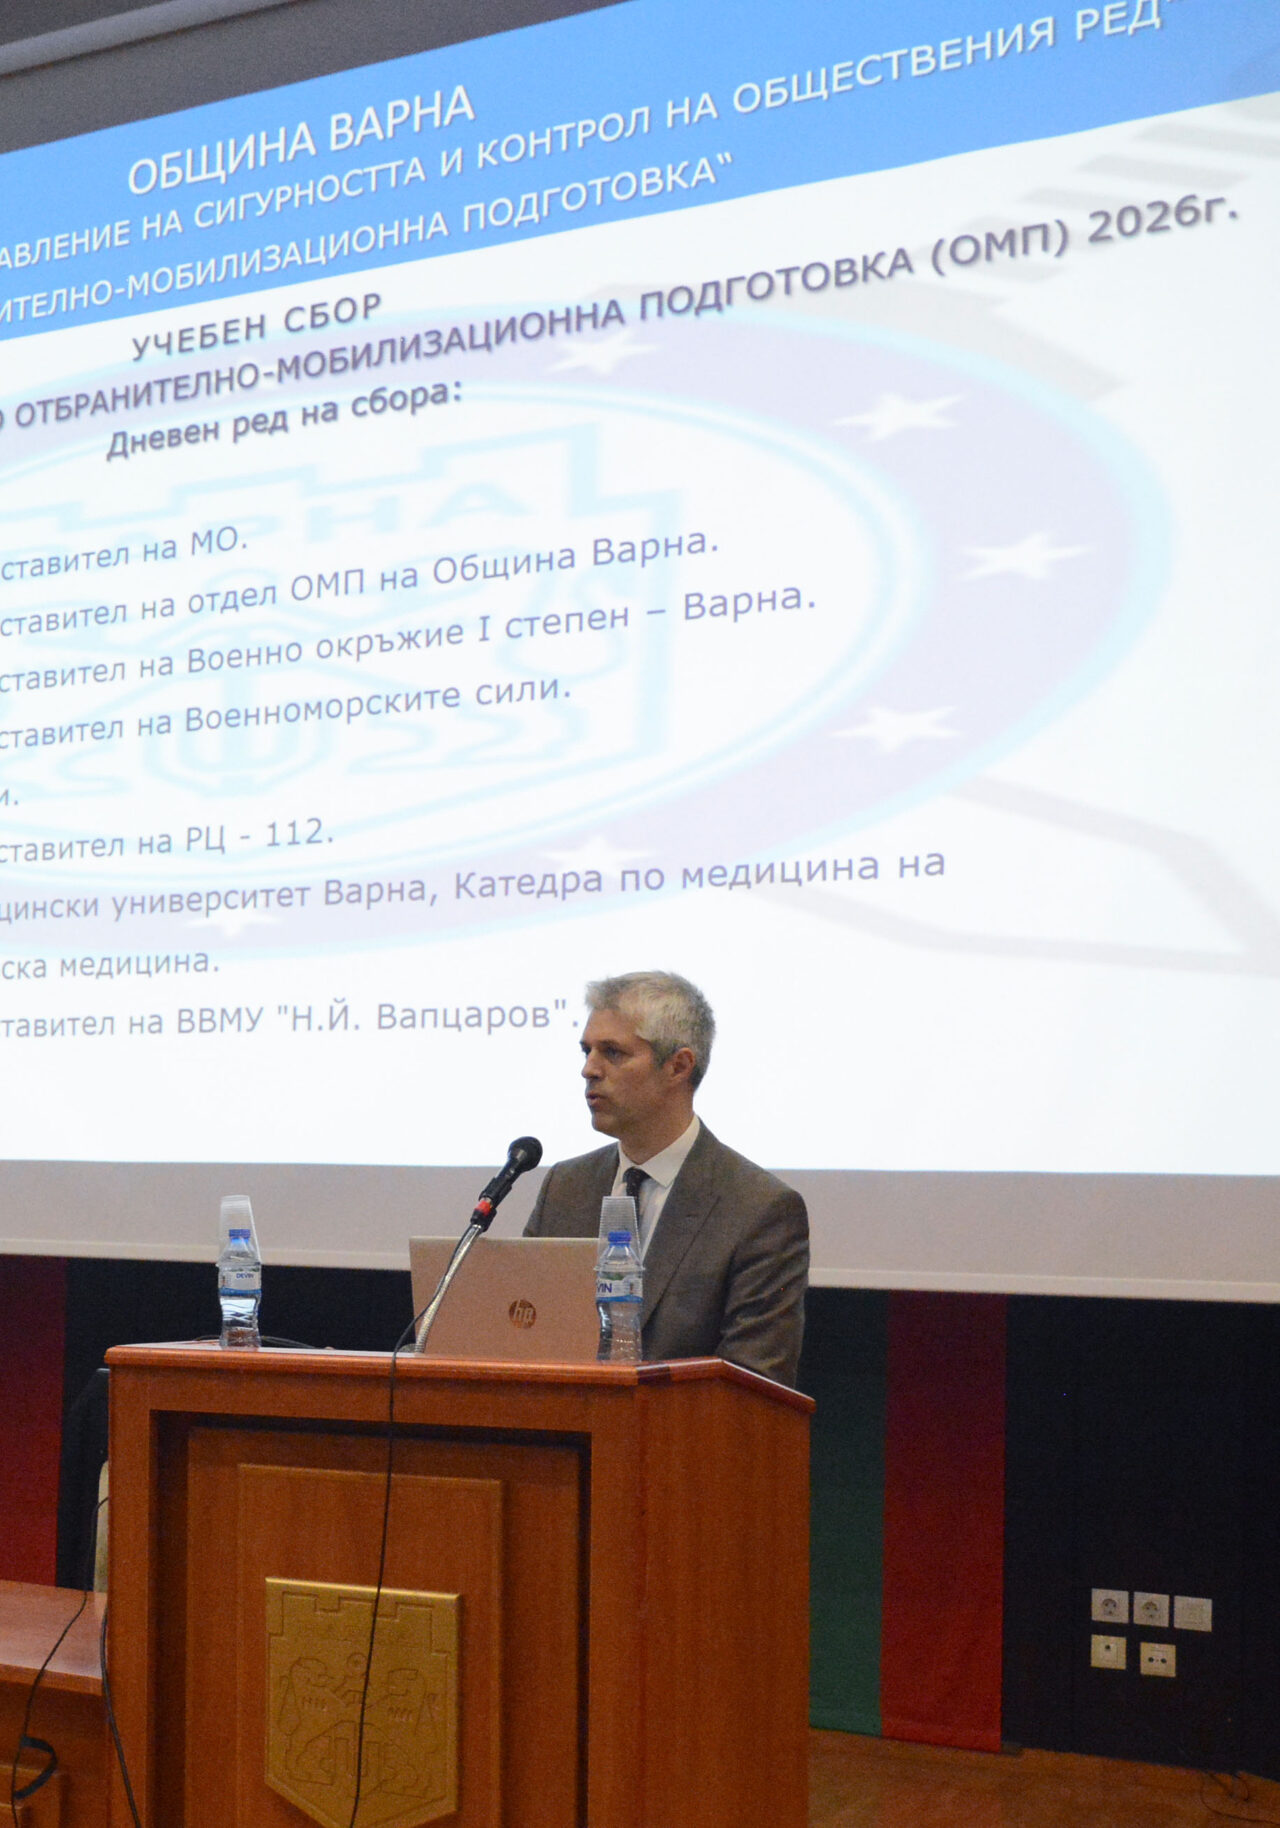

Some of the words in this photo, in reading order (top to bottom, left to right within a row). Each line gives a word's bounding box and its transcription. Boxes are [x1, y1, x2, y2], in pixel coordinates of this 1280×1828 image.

[128, 121, 317, 195] ОБЩИНА
[330, 88, 476, 151] ВАРНА
[142, 209, 184, 240] НА
[194, 157, 426, 228] СИГУРНОСТТА
[441, 148, 463, 177] И
[478, 107, 650, 169] КОНТРОЛ
[666, 93, 718, 128] НА
[733, 16, 1054, 113] ОБЩЕСТВЕНИЯ
[1076, 0, 1180, 41] РЕД
[14, 298, 628, 429] ОТБРАНИТЕЛНО-МОБИЛИЗАЦИОННА
[639, 246, 916, 324] ПОДГОТОВКА
[930, 218, 1072, 278] (ОМП)
[1086, 193, 1240, 247] 2026г.
[131, 313, 266, 364] УЧЕБЕН
[283, 292, 382, 335] СБОР
[105, 420, 221, 463] Дневен
[232, 409, 290, 445] ред
[301, 400, 340, 428] на
[350, 380, 463, 419] сбора:
[141, 597, 175, 621] на
[187, 584, 277, 615] отдел
[290, 567, 365, 602] ОМП
[380, 567, 419, 592] на
[432, 547, 576, 585] Община
[592, 531, 718, 569] Варна.
[143, 539, 177, 563] на
[190, 525, 248, 557] МО.
[139, 655, 174, 679] на
[187, 641, 303, 674] Военно
[315, 623, 464, 660] окръжие
[504, 606, 629, 640] степен
[684, 586, 816, 624] Варна.
[137, 714, 172, 737] на
[185, 686, 461, 733] Военноморските
[475, 678, 571, 706] сили.
[138, 833, 172, 856] на
[186, 824, 226, 855] РЦ
[265, 816, 335, 849] 112.
[111, 885, 312, 923] университет
[324, 878, 438, 911] Варна,
[455, 869, 603, 902] Катедра
[620, 867, 666, 893] по
[681, 856, 879, 891] медицина
[898, 852, 945, 879] на
[60, 951, 219, 980] медицина.
[128, 1013, 163, 1035] на
[177, 1006, 264, 1034] ВВМУ
[277, 996, 360, 1032] "Н.Й.
[378, 997, 580, 1034] Вапцаров".
[235, 1272, 255, 1280] DEVIN
[596, 1282, 613, 1294] VIN
